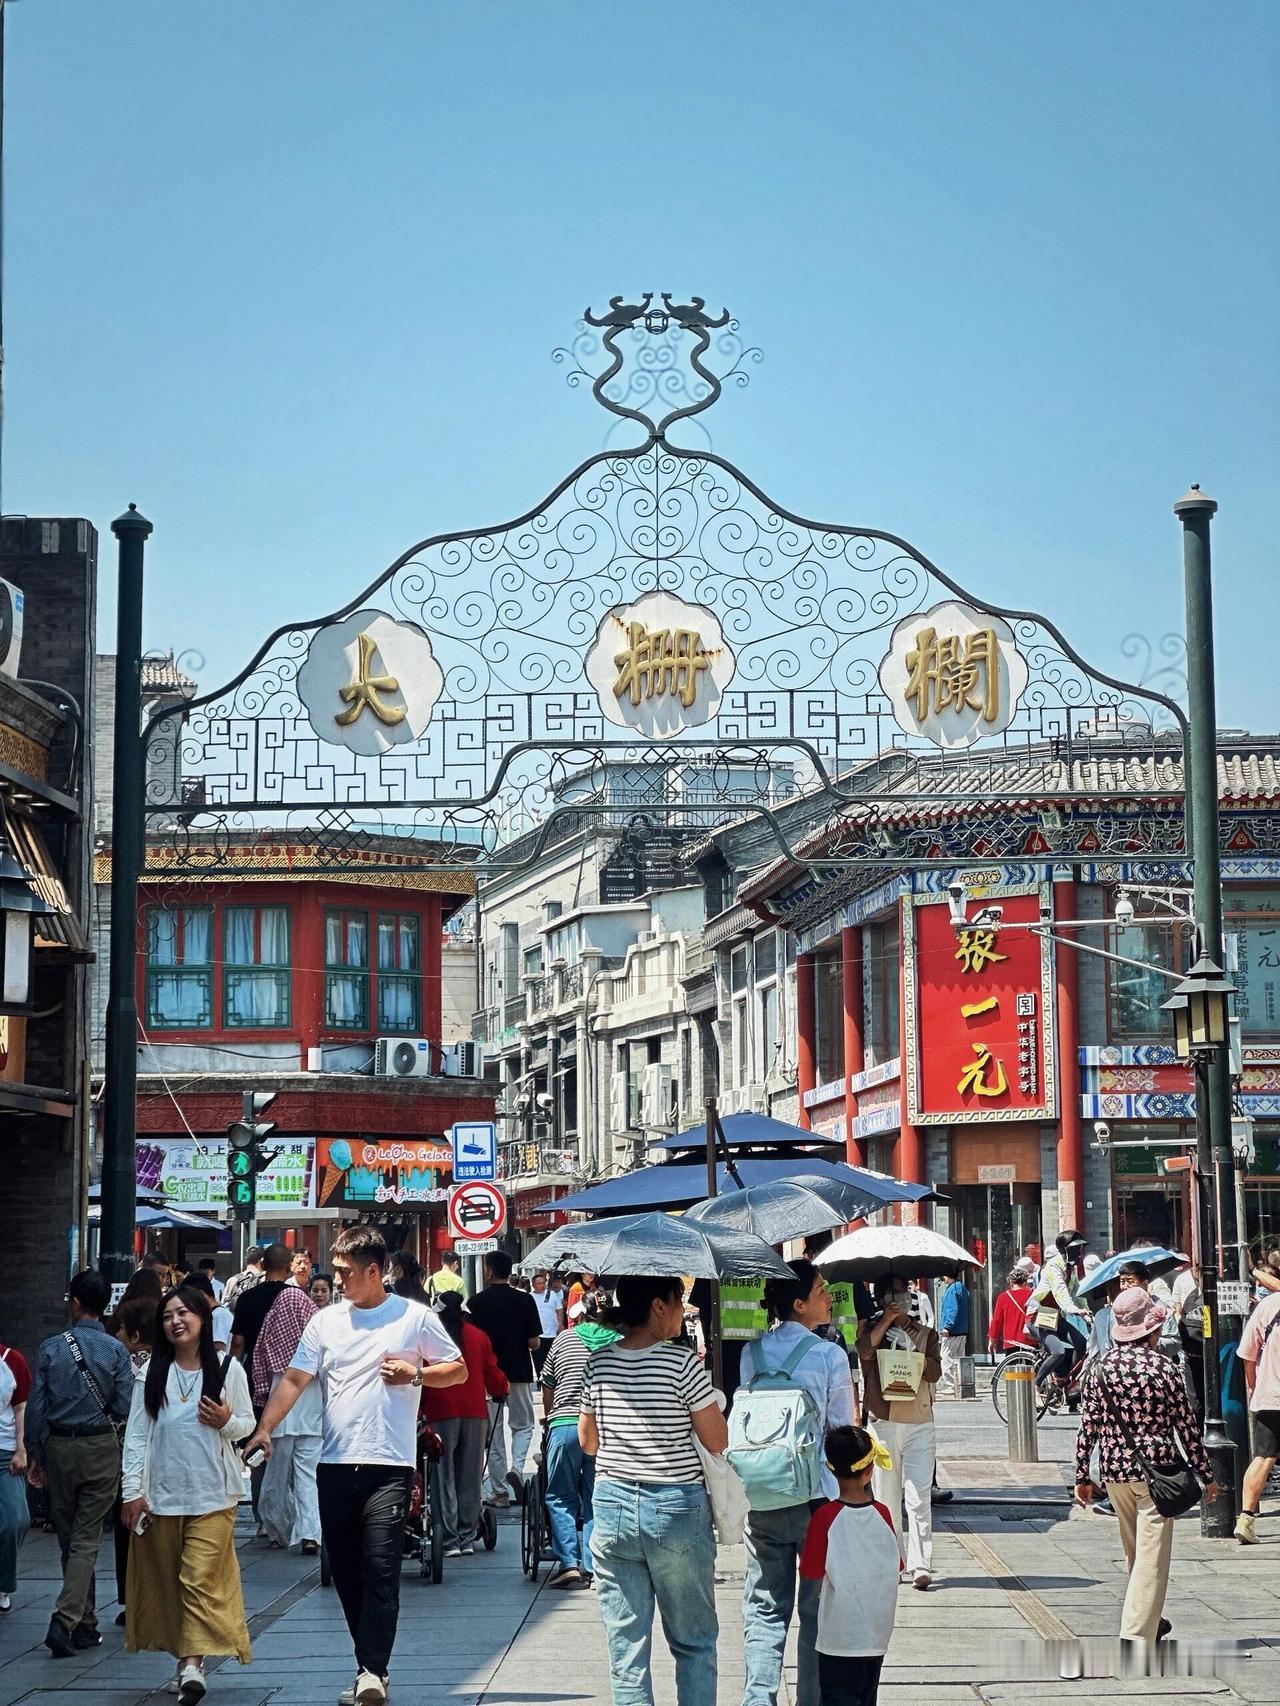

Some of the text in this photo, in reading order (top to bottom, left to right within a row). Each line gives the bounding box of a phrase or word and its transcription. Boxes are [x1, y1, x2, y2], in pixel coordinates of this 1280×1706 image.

[955, 930, 1008, 1097] 张一元
[1018, 1022, 1029, 1092] 中华老字号
[418, 1150, 453, 1161] Gelato
